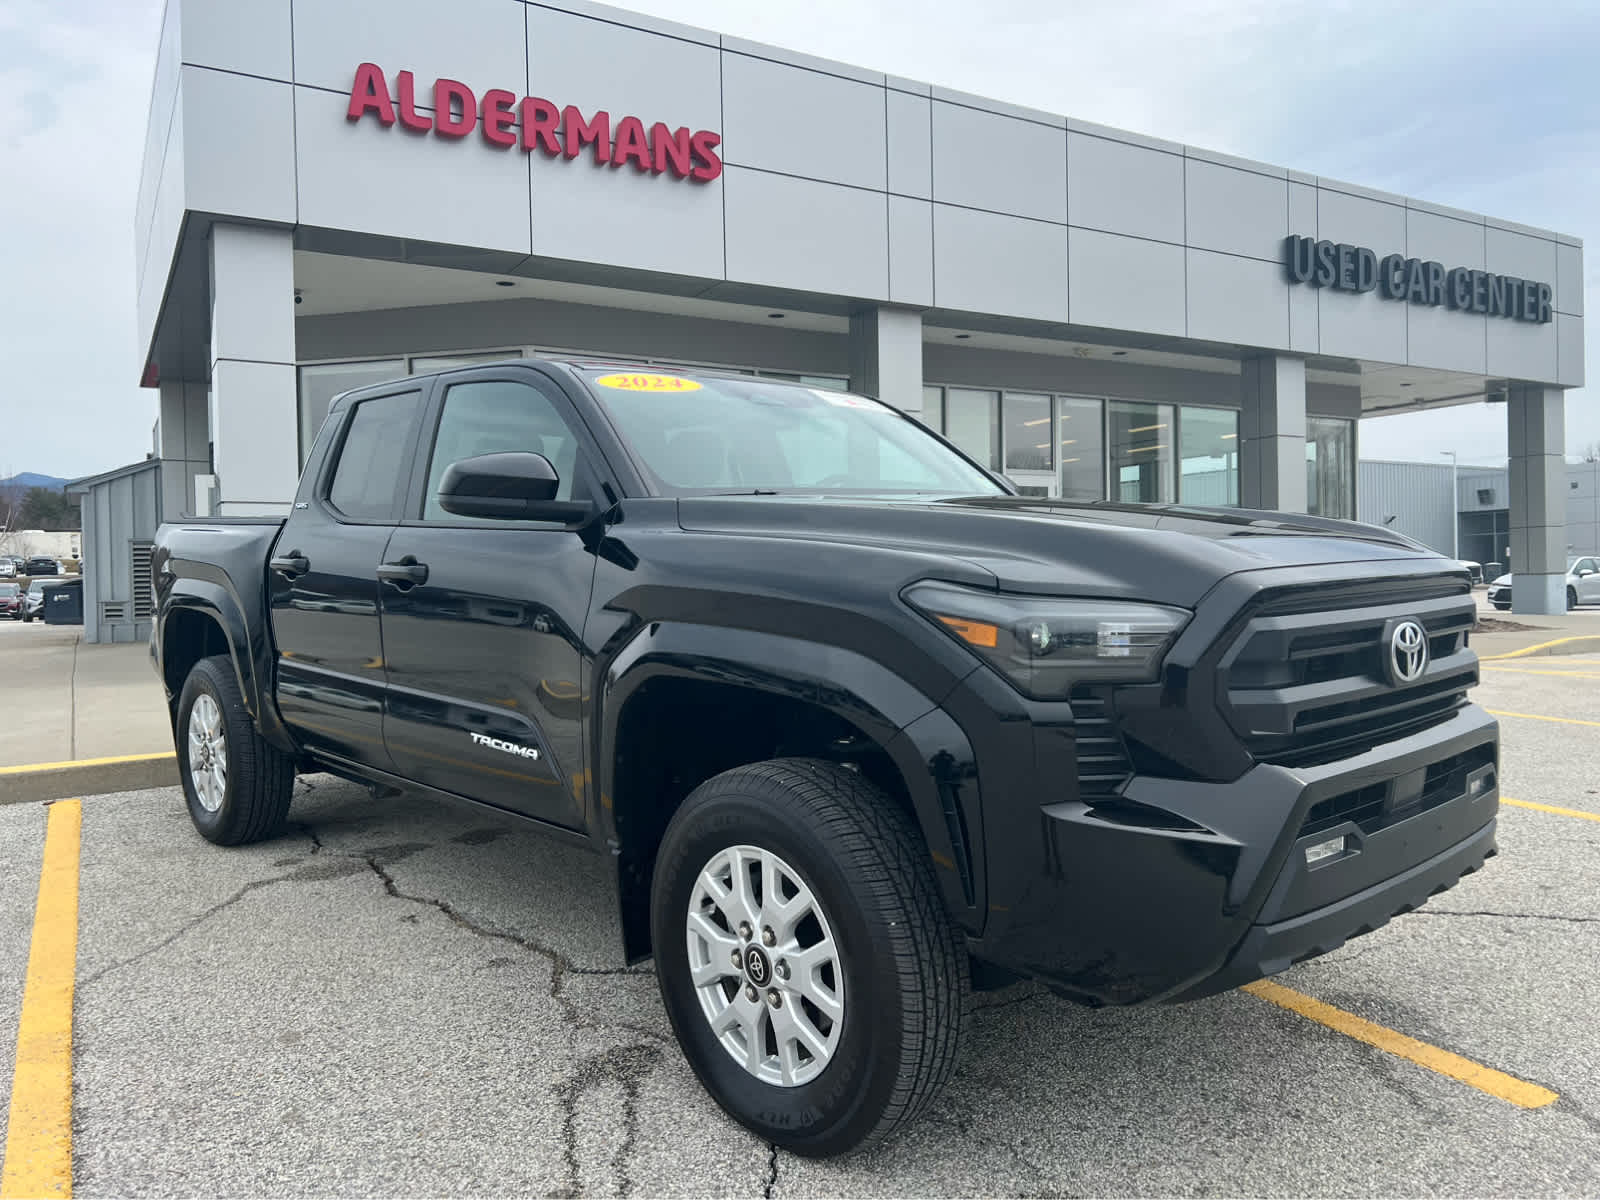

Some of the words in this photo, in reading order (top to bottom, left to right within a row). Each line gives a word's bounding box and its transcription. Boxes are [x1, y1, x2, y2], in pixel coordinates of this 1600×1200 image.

[346, 62, 722, 183] ALDERMANS
[1286, 234, 1377, 294] USED
[1381, 253, 1446, 306] CAR
[1448, 266, 1553, 323] CENTER
[616, 376, 684, 389] 2024
[470, 732, 539, 760] TACOMA
